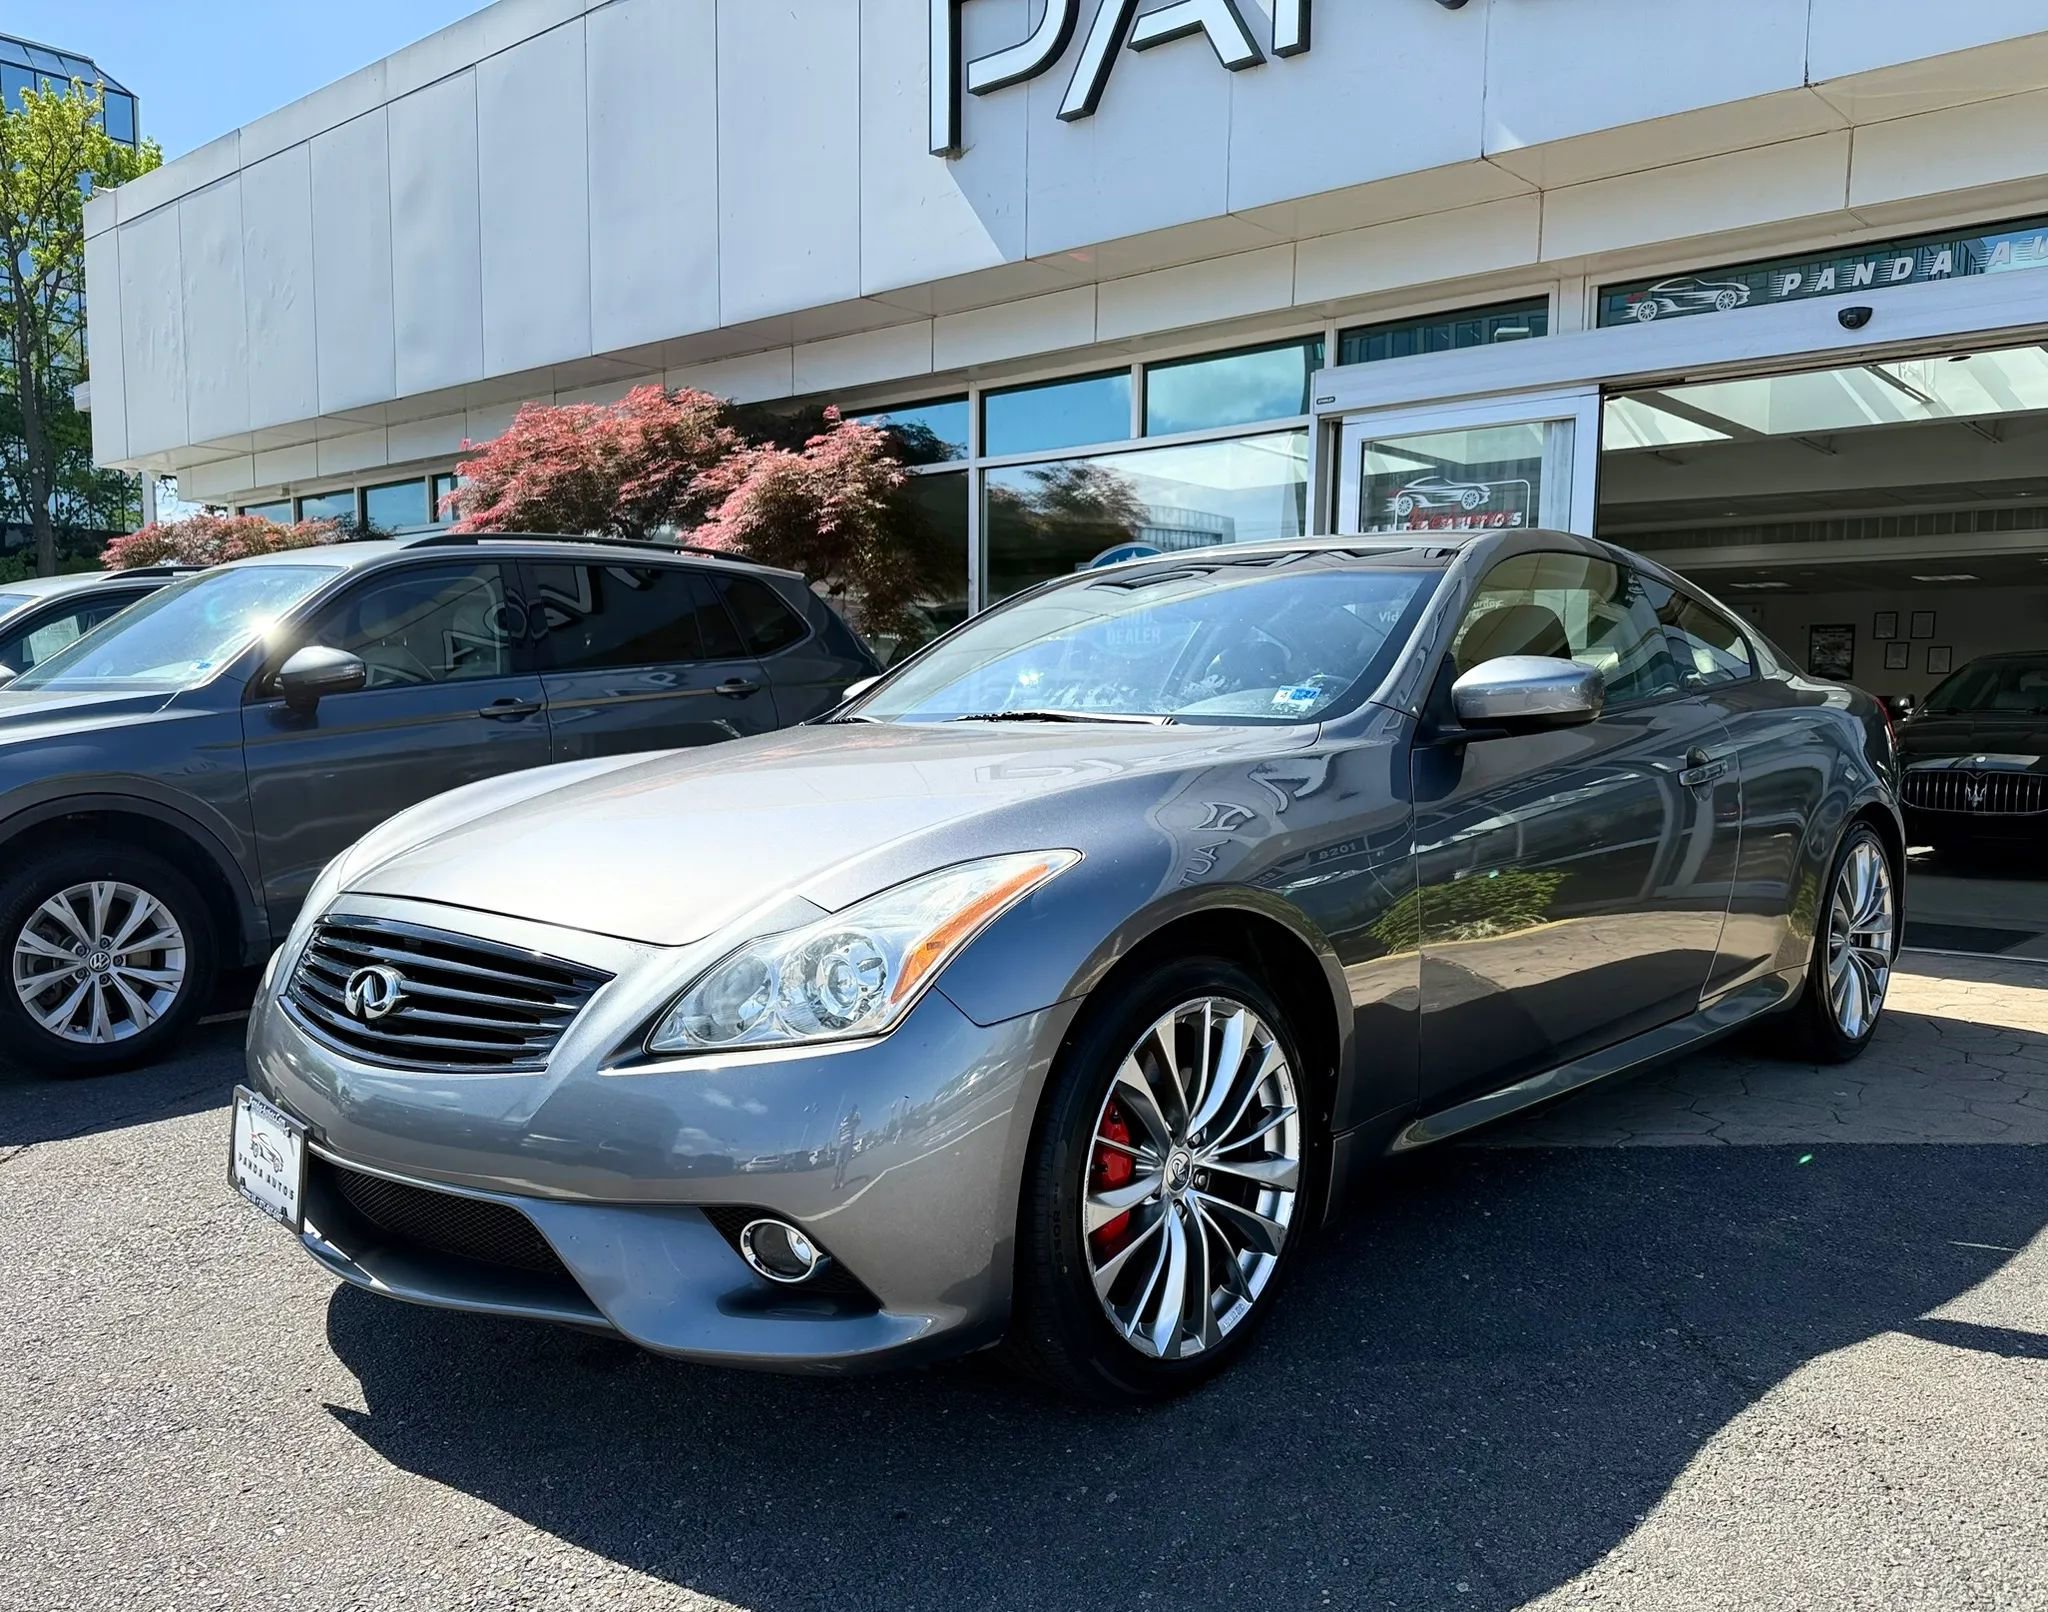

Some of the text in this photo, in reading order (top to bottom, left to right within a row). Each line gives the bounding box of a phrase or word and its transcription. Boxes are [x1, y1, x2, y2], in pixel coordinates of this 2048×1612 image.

[1770, 250, 1952, 297] PANDA
[238, 1152, 295, 1200] PANDA AUTOS
